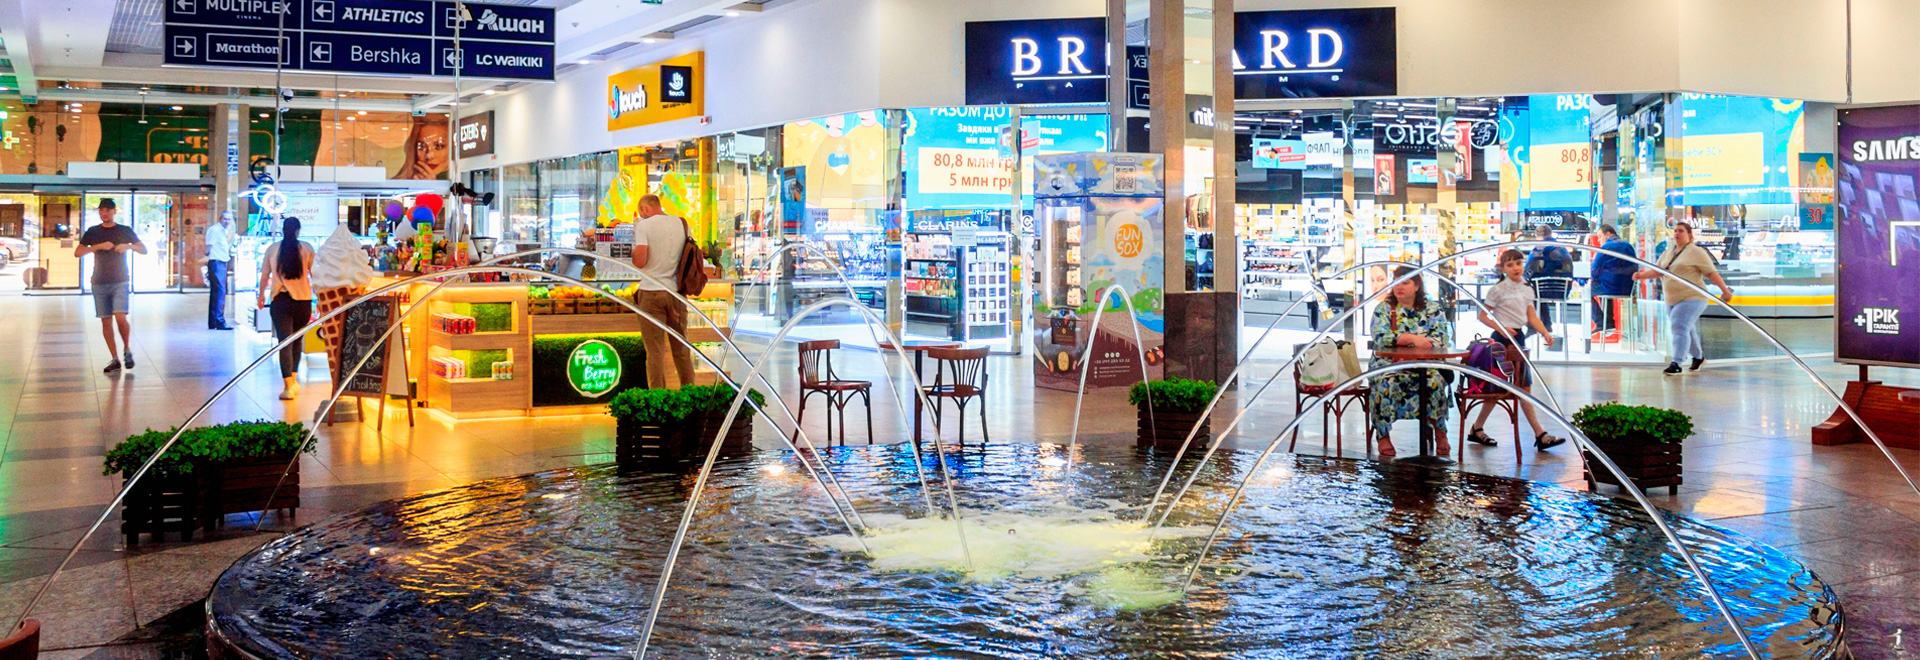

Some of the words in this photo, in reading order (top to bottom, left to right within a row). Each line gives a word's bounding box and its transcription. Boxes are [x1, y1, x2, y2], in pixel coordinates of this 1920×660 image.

[206, 0, 291, 14] MULTIPLEX
[342, 7, 425, 24] ATHLETICS
[216, 43, 279, 55] Marathon
[350, 45, 421, 64] Bershka
[476, 54, 492, 65] LC
[620, 84, 647, 112] touch
[957, 123, 993, 134] Завдяки
[980, 136, 996, 144] вже
[934, 153, 963, 168] 80,8
[949, 173, 957, 186] 5
[961, 176, 989, 187] млн
[1116, 228, 1140, 240] FUN
[1118, 241, 1140, 255] SOX
[574, 349, 608, 366] Fresh
[584, 366, 616, 384] Berry
